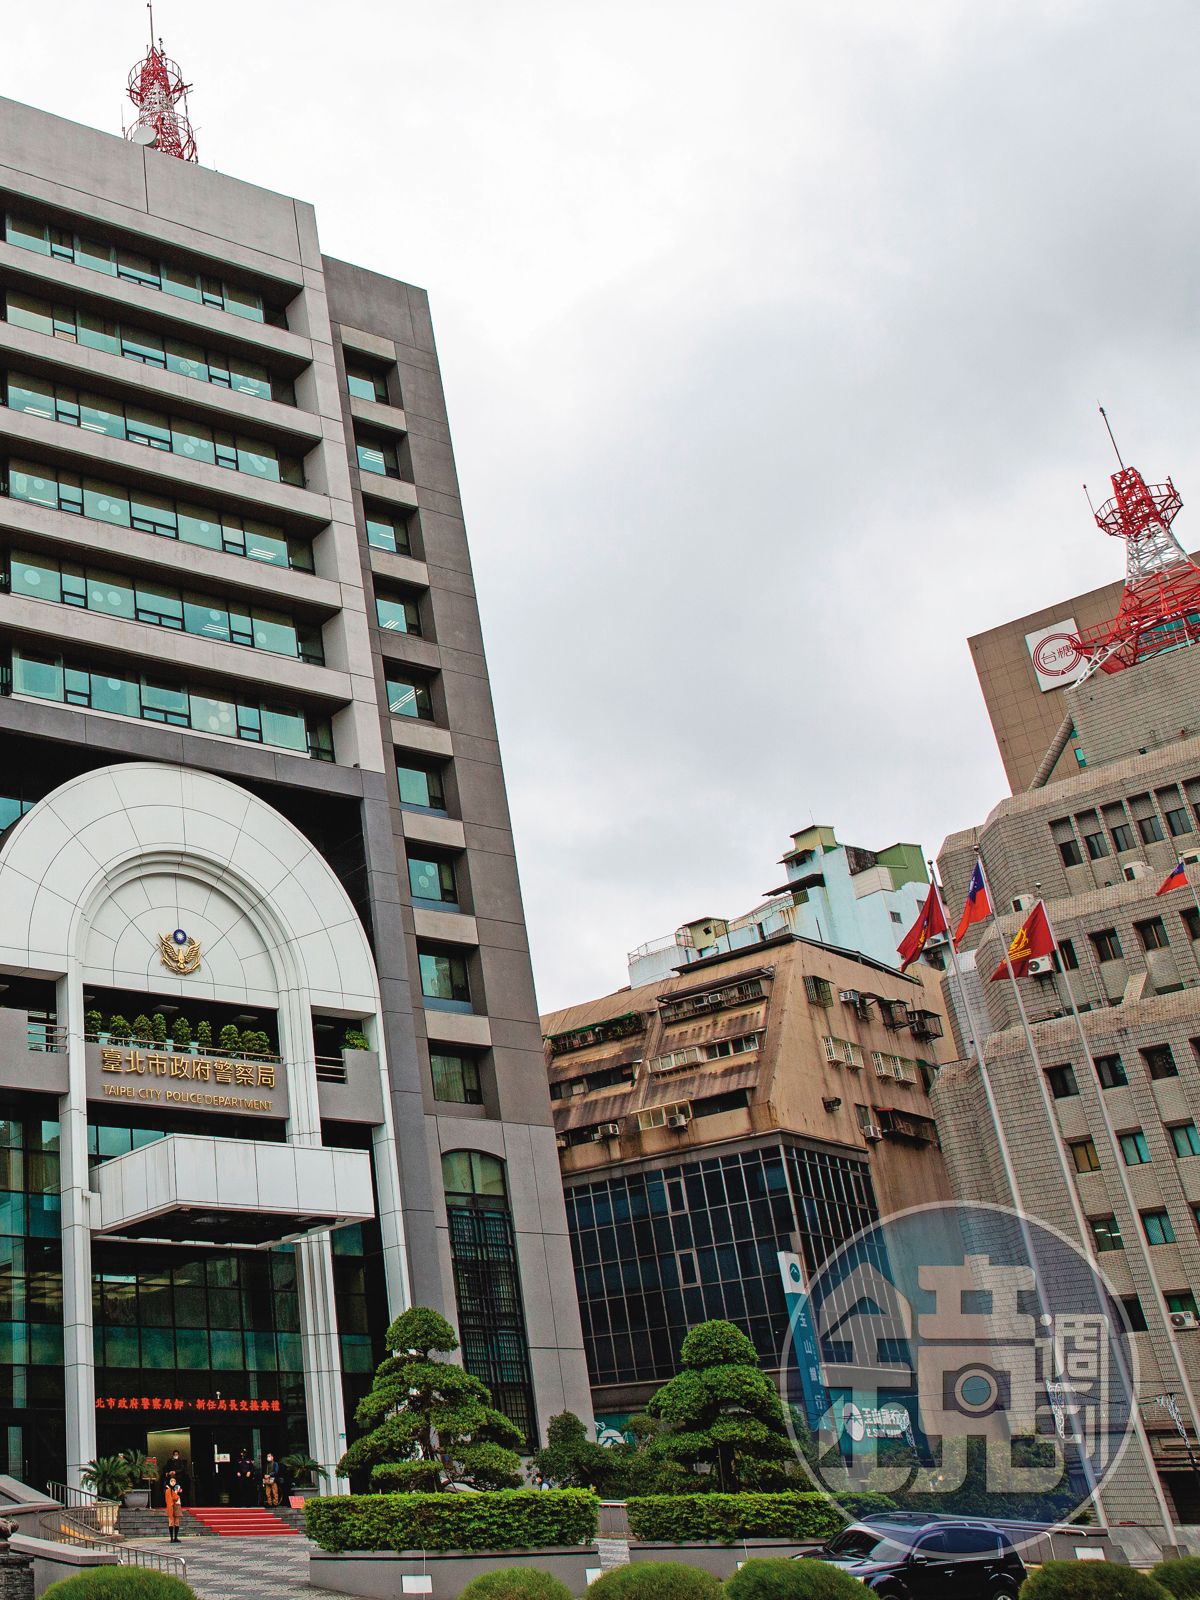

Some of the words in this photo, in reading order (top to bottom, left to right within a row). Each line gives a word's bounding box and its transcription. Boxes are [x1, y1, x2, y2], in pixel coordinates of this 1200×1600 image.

[1041, 644, 1074, 664] 台糖
[102, 1048, 276, 1088] 臺北市政府警察局
[103, 1084, 136, 1097] TAIPEI
[138, 1088, 162, 1100] CITY
[166, 1090, 202, 1104] POLICE
[205, 1094, 273, 1111] DEPARTMENT
[798, 1312, 823, 1410] 玉山銀行
[96, 1397, 281, 1412] 北市政府警察局卸、新任局長交接典禮
